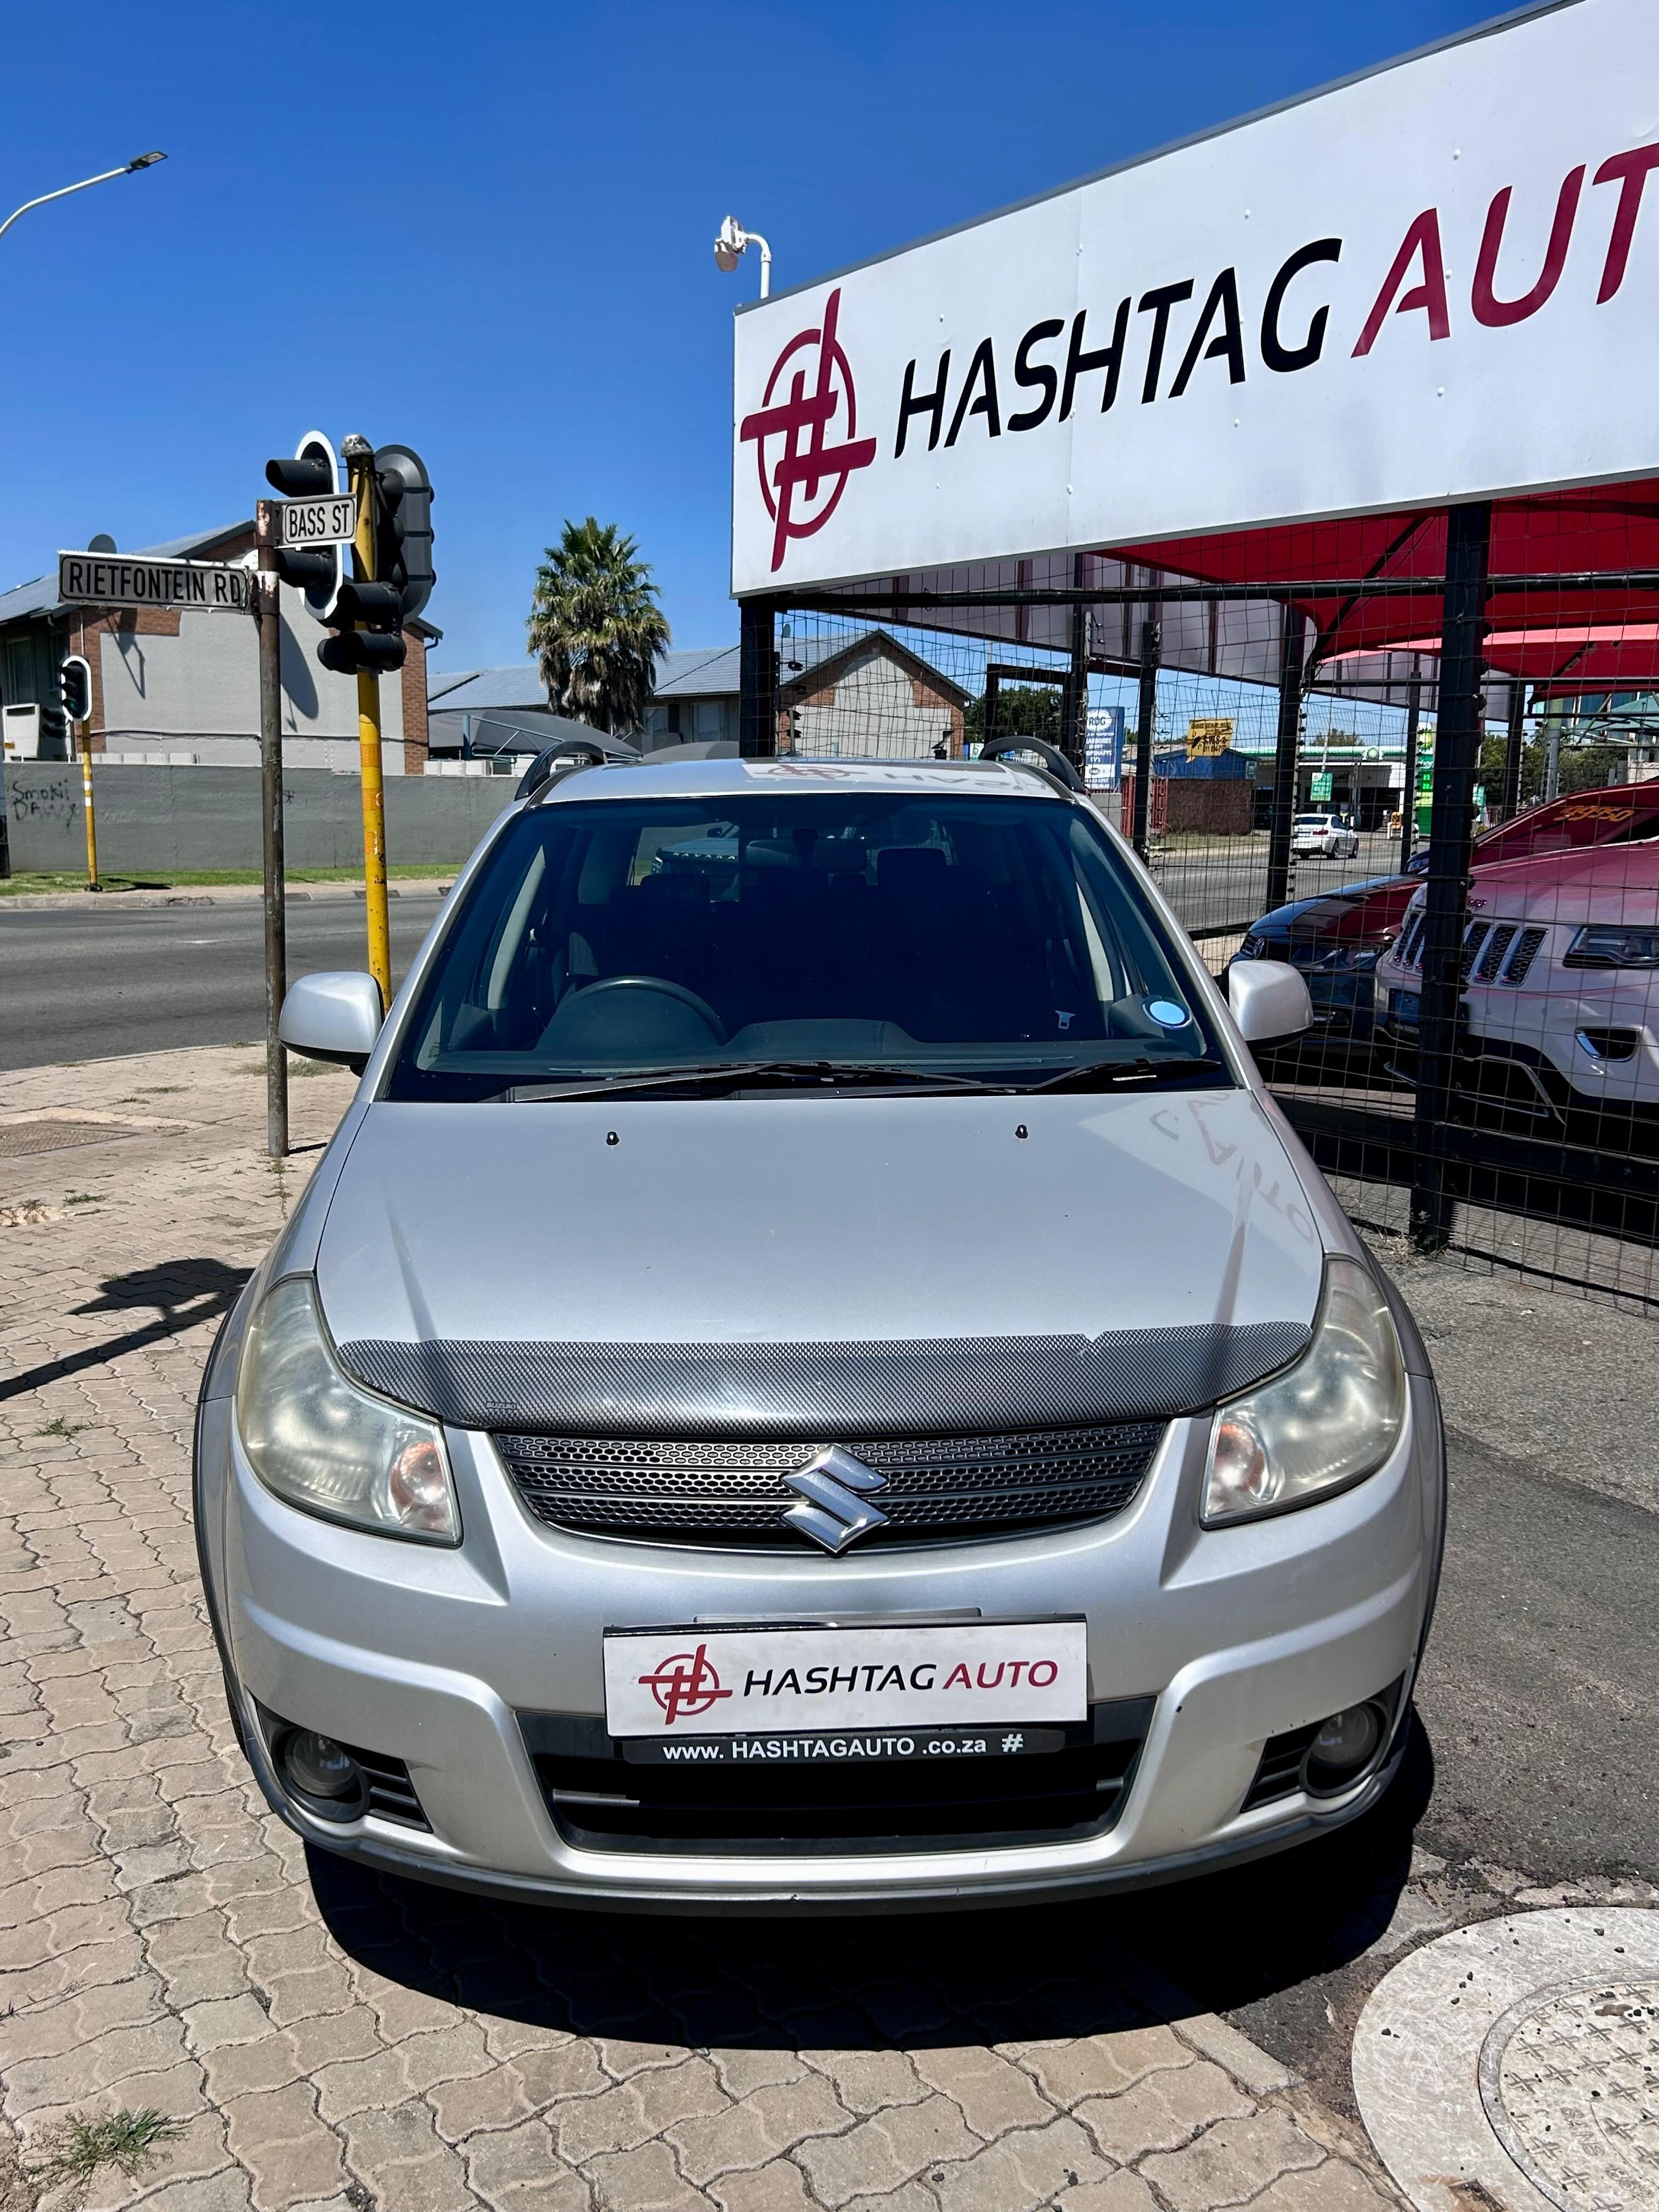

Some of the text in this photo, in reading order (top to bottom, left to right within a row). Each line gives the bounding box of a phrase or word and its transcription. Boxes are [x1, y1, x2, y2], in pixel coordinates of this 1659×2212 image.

[895, 142, 1659, 459] HASHTAG AUT
[290, 504, 350, 538] BASS ST
[69, 562, 241, 603] RIETFONTEIN RD
[743, 1660, 1058, 1697] HASHTAG AUTO
[663, 1733, 1024, 1760] www. HASHTAGAUTO .co.za #
